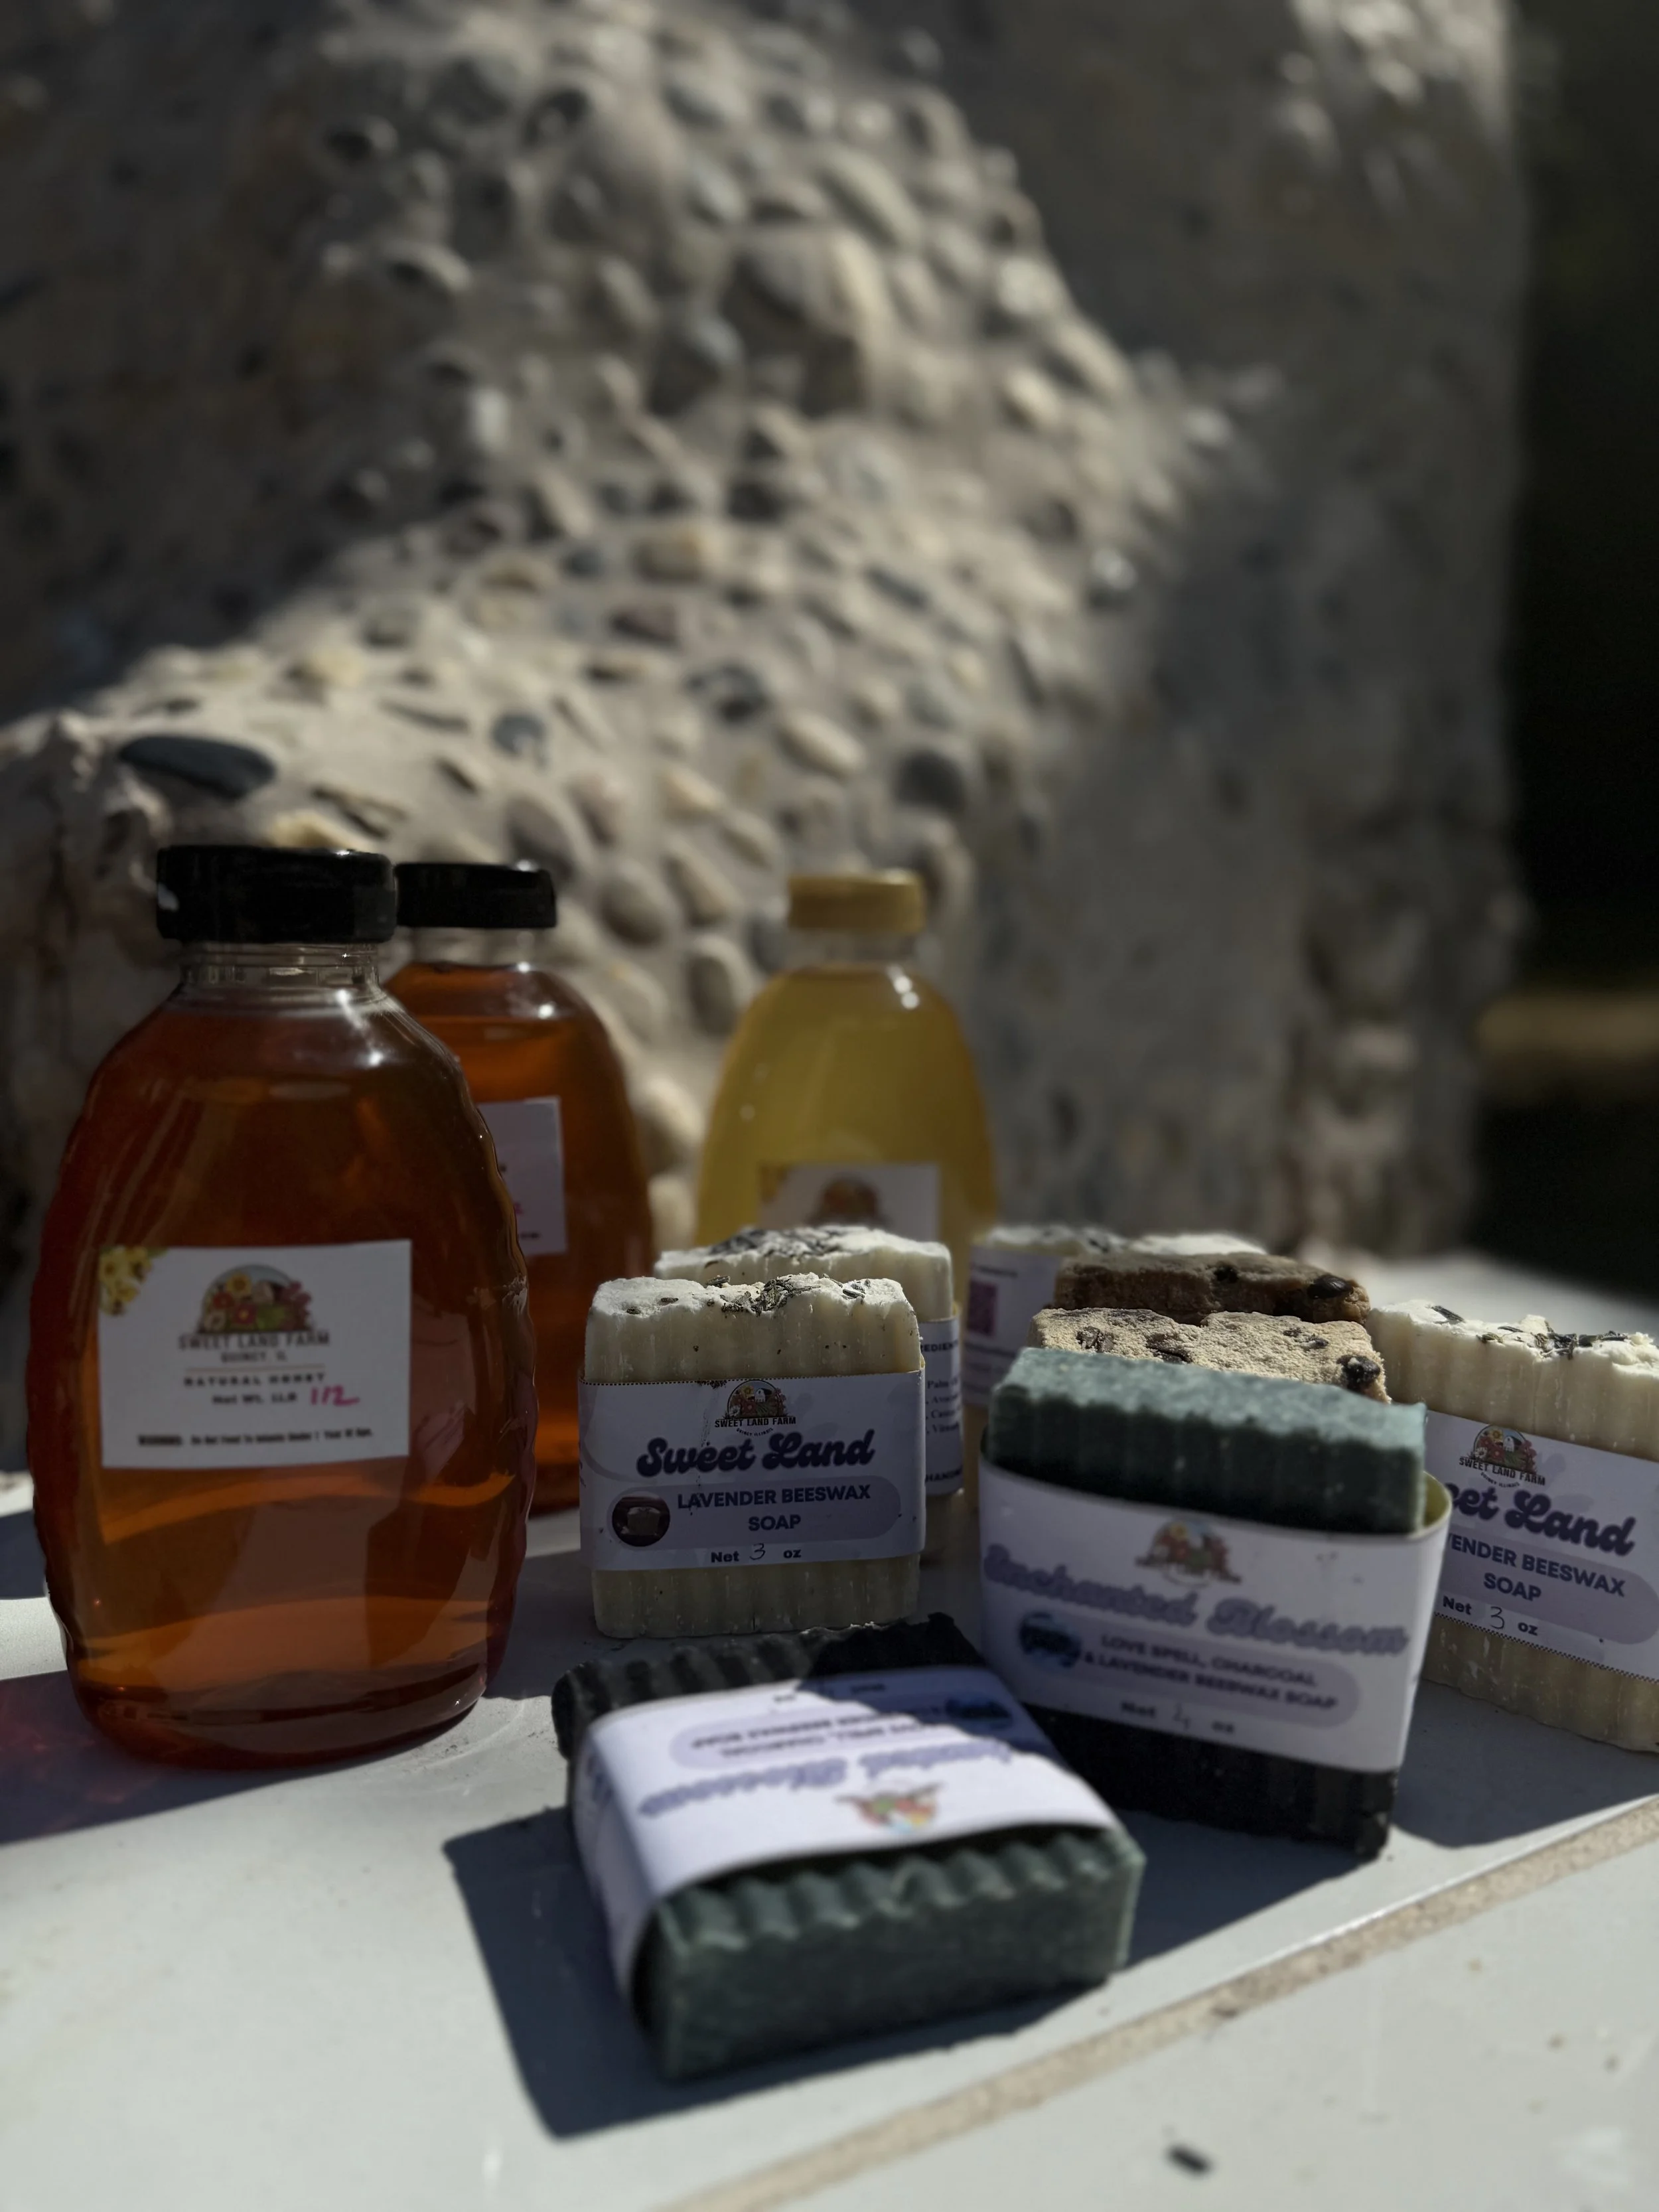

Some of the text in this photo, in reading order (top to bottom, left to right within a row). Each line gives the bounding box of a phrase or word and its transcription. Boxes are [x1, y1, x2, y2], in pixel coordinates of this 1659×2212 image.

[239, 1333, 279, 1347] LAND
[184, 1372, 326, 1388] NATURAL HONEY
[714, 1416, 796, 1428] SWEET LAND FARM
[636, 1429, 875, 1477] Sweet Land
[1459, 1456, 1546, 1486] SWEET LAND FARM
[677, 1484, 871, 1510] LAVENDER BEESWAX
[748, 1514, 802, 1532] SOAP
[1445, 1481, 1636, 1557] eet Land
[710, 1542, 802, 1564] Net 3 oz
[1483, 1572, 1542, 1602] SOAP
[1522, 1553, 1625, 1598] BEESWAX
[1442, 1594, 1538, 1637] Net 3 oz
[1101, 1633, 1146, 1655] LOVE
[1285, 1689, 1339, 1710] SOAP
